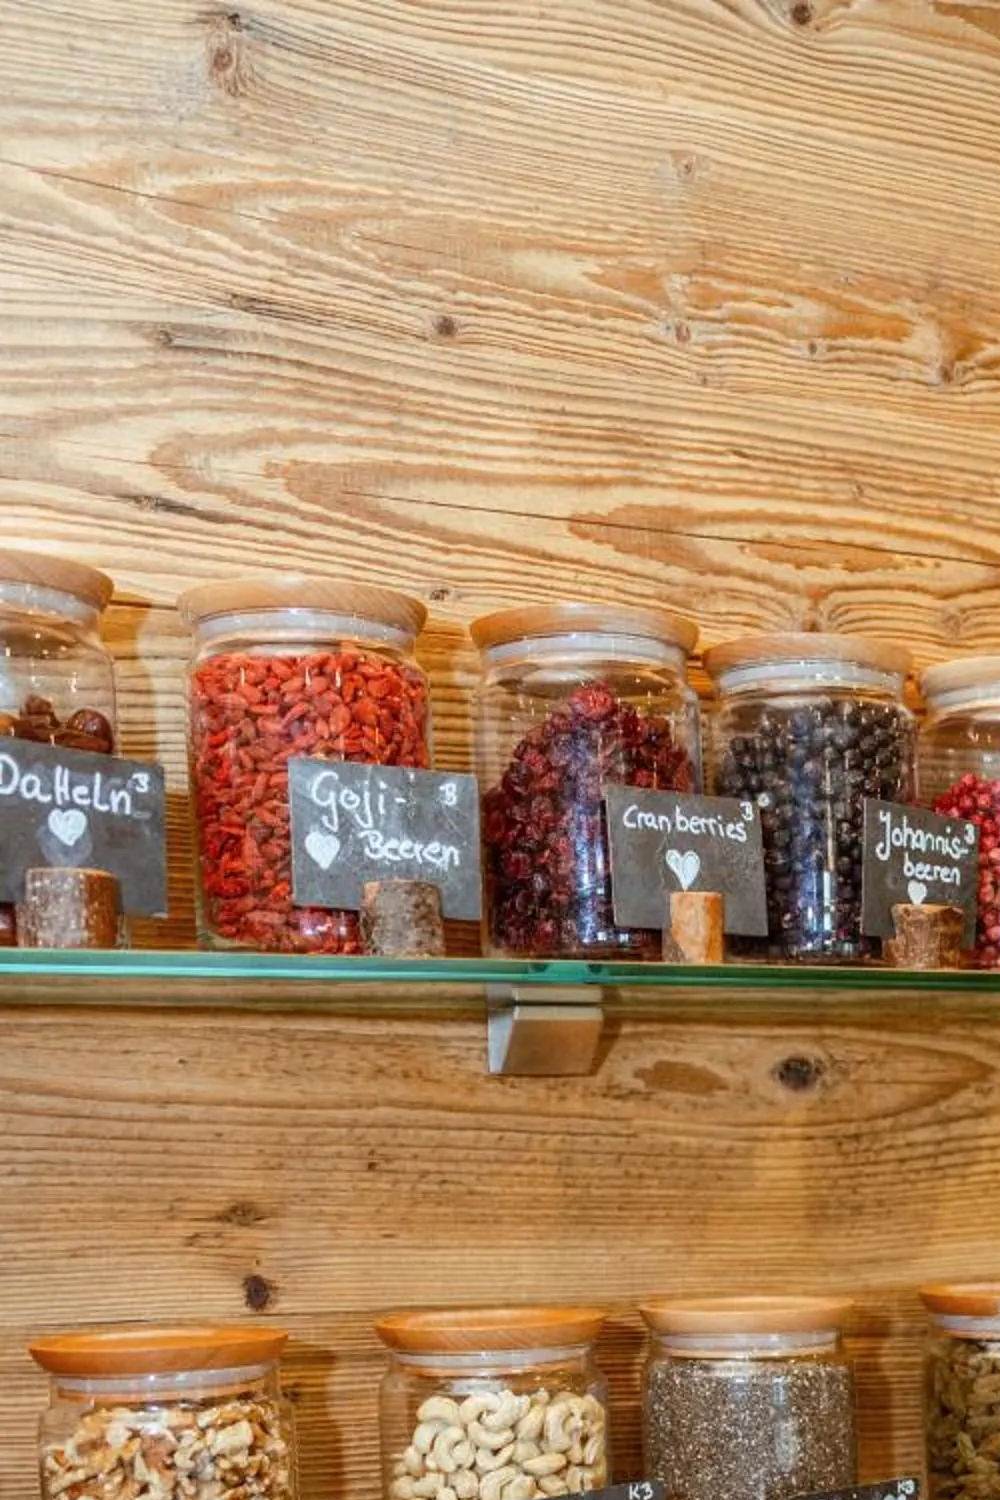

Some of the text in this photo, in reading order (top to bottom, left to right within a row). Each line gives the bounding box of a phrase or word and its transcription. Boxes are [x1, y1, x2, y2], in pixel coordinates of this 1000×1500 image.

[311, 771, 406, 832] Goji-
[623, 804, 747, 843] Cranberries
[358, 830, 460, 871] Beeren
[903, 851, 961, 886] beeren
[628, 1482, 653, 1500] K3
